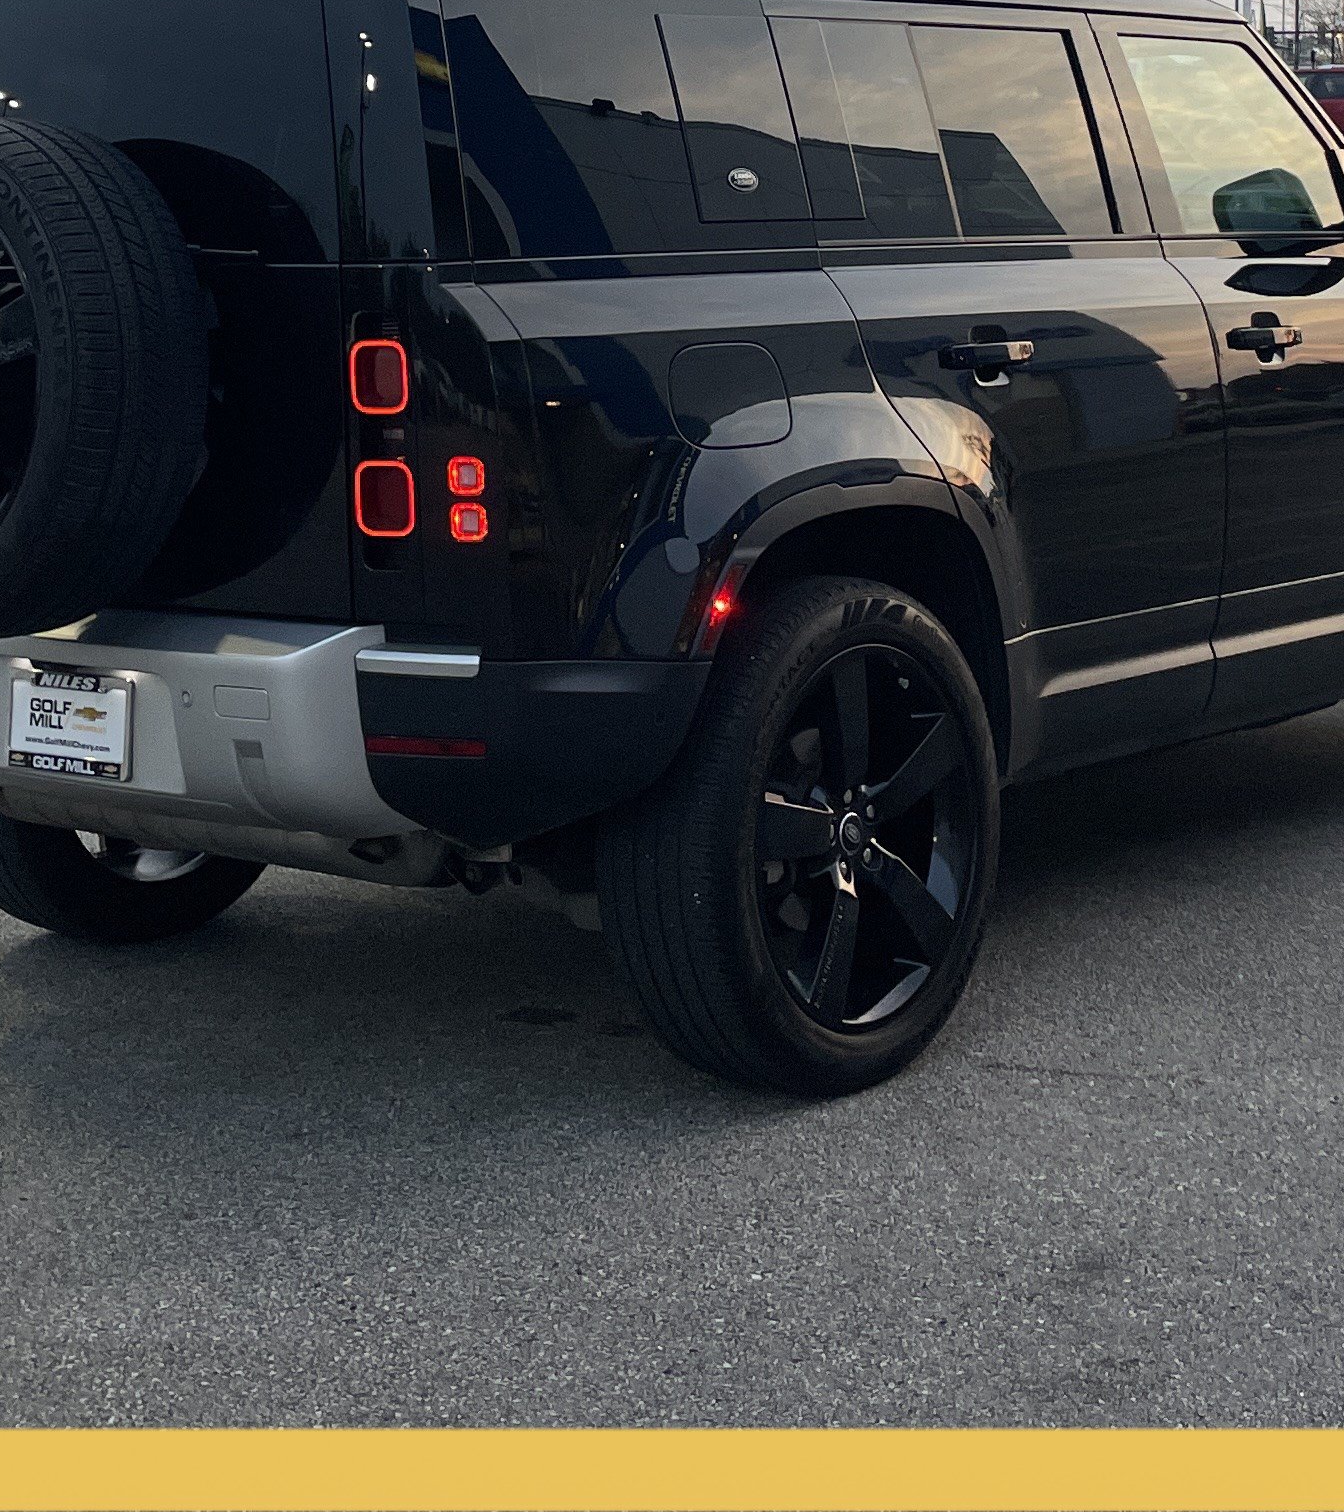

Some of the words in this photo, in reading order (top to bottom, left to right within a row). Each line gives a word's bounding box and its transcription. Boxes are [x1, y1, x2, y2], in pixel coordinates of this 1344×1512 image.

[39, 672, 96, 692] NILES
[30, 697, 72, 714] GOLF
[29, 712, 64, 730] MILL
[32, 755, 65, 771] GOLF
[65, 759, 95, 776] MILL
